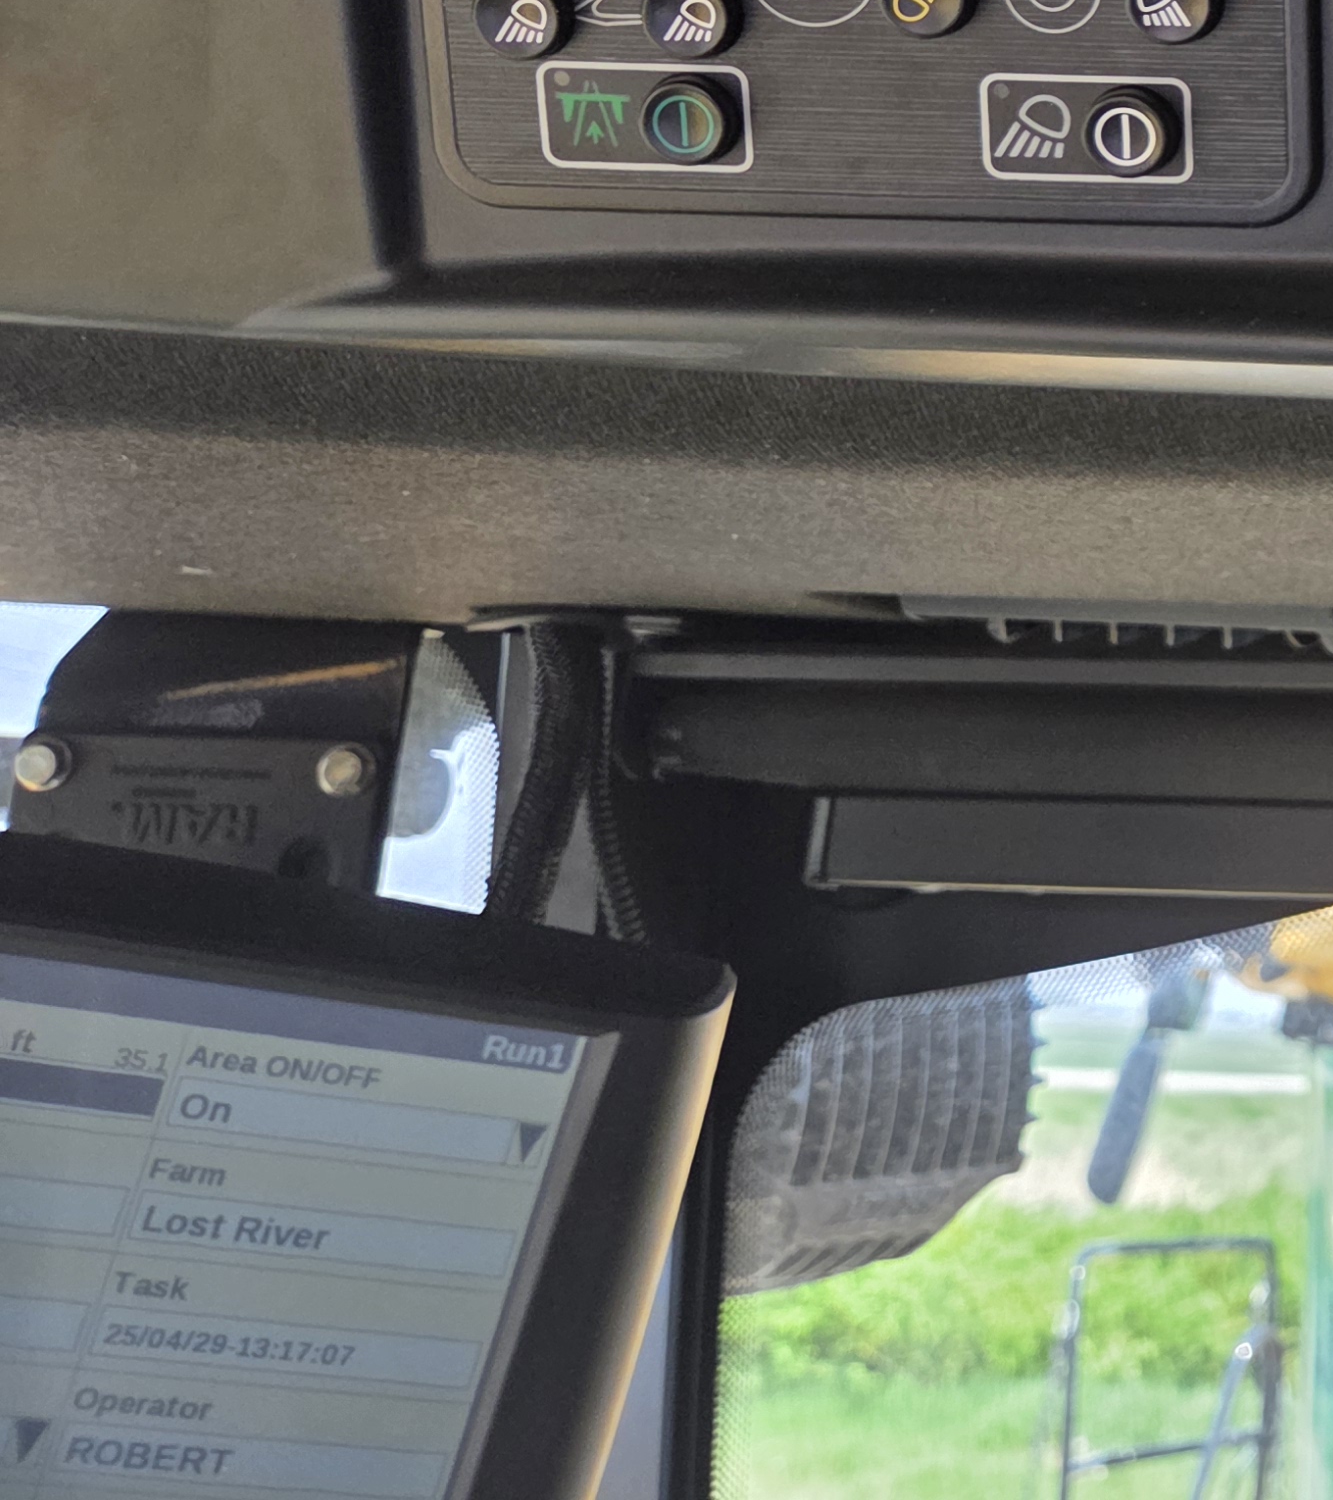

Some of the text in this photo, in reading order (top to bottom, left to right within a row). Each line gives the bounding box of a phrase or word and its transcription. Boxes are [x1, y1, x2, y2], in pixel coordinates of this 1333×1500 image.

[11, 1029, 36, 1054] ft
[481, 1035, 565, 1069] Run1
[114, 1047, 168, 1072] 35.1
[186, 1045, 381, 1090] Area ON/OFF
[179, 1094, 232, 1124] On
[148, 1157, 226, 1187] Farm
[141, 1206, 330, 1251] Lost River
[113, 1271, 189, 1301] Task
[104, 1323, 356, 1367] 25/04/29-13:17:07
[73, 1387, 212, 1422] Operator
[64, 1437, 234, 1475] ROBERT
